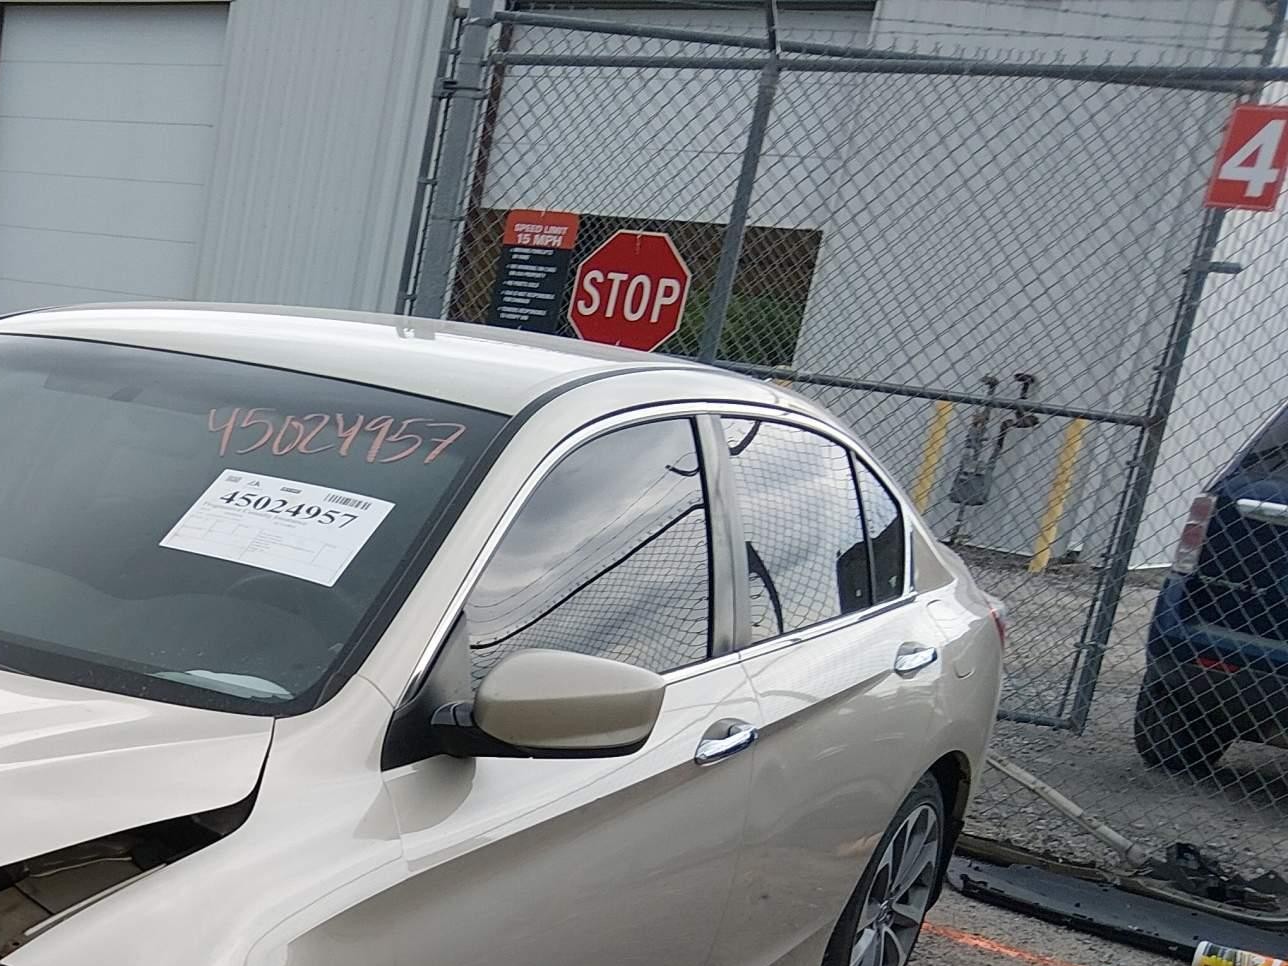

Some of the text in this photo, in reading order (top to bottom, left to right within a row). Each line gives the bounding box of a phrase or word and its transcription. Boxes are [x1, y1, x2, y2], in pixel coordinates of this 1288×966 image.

[1219, 119, 1287, 198] 4
[514, 223, 568, 235] SPEED LIMIT
[517, 233, 563, 247] 15 MPH
[577, 269, 681, 324] STOP
[208, 407, 467, 465] 45024957
[220, 490, 359, 529] 45024957
